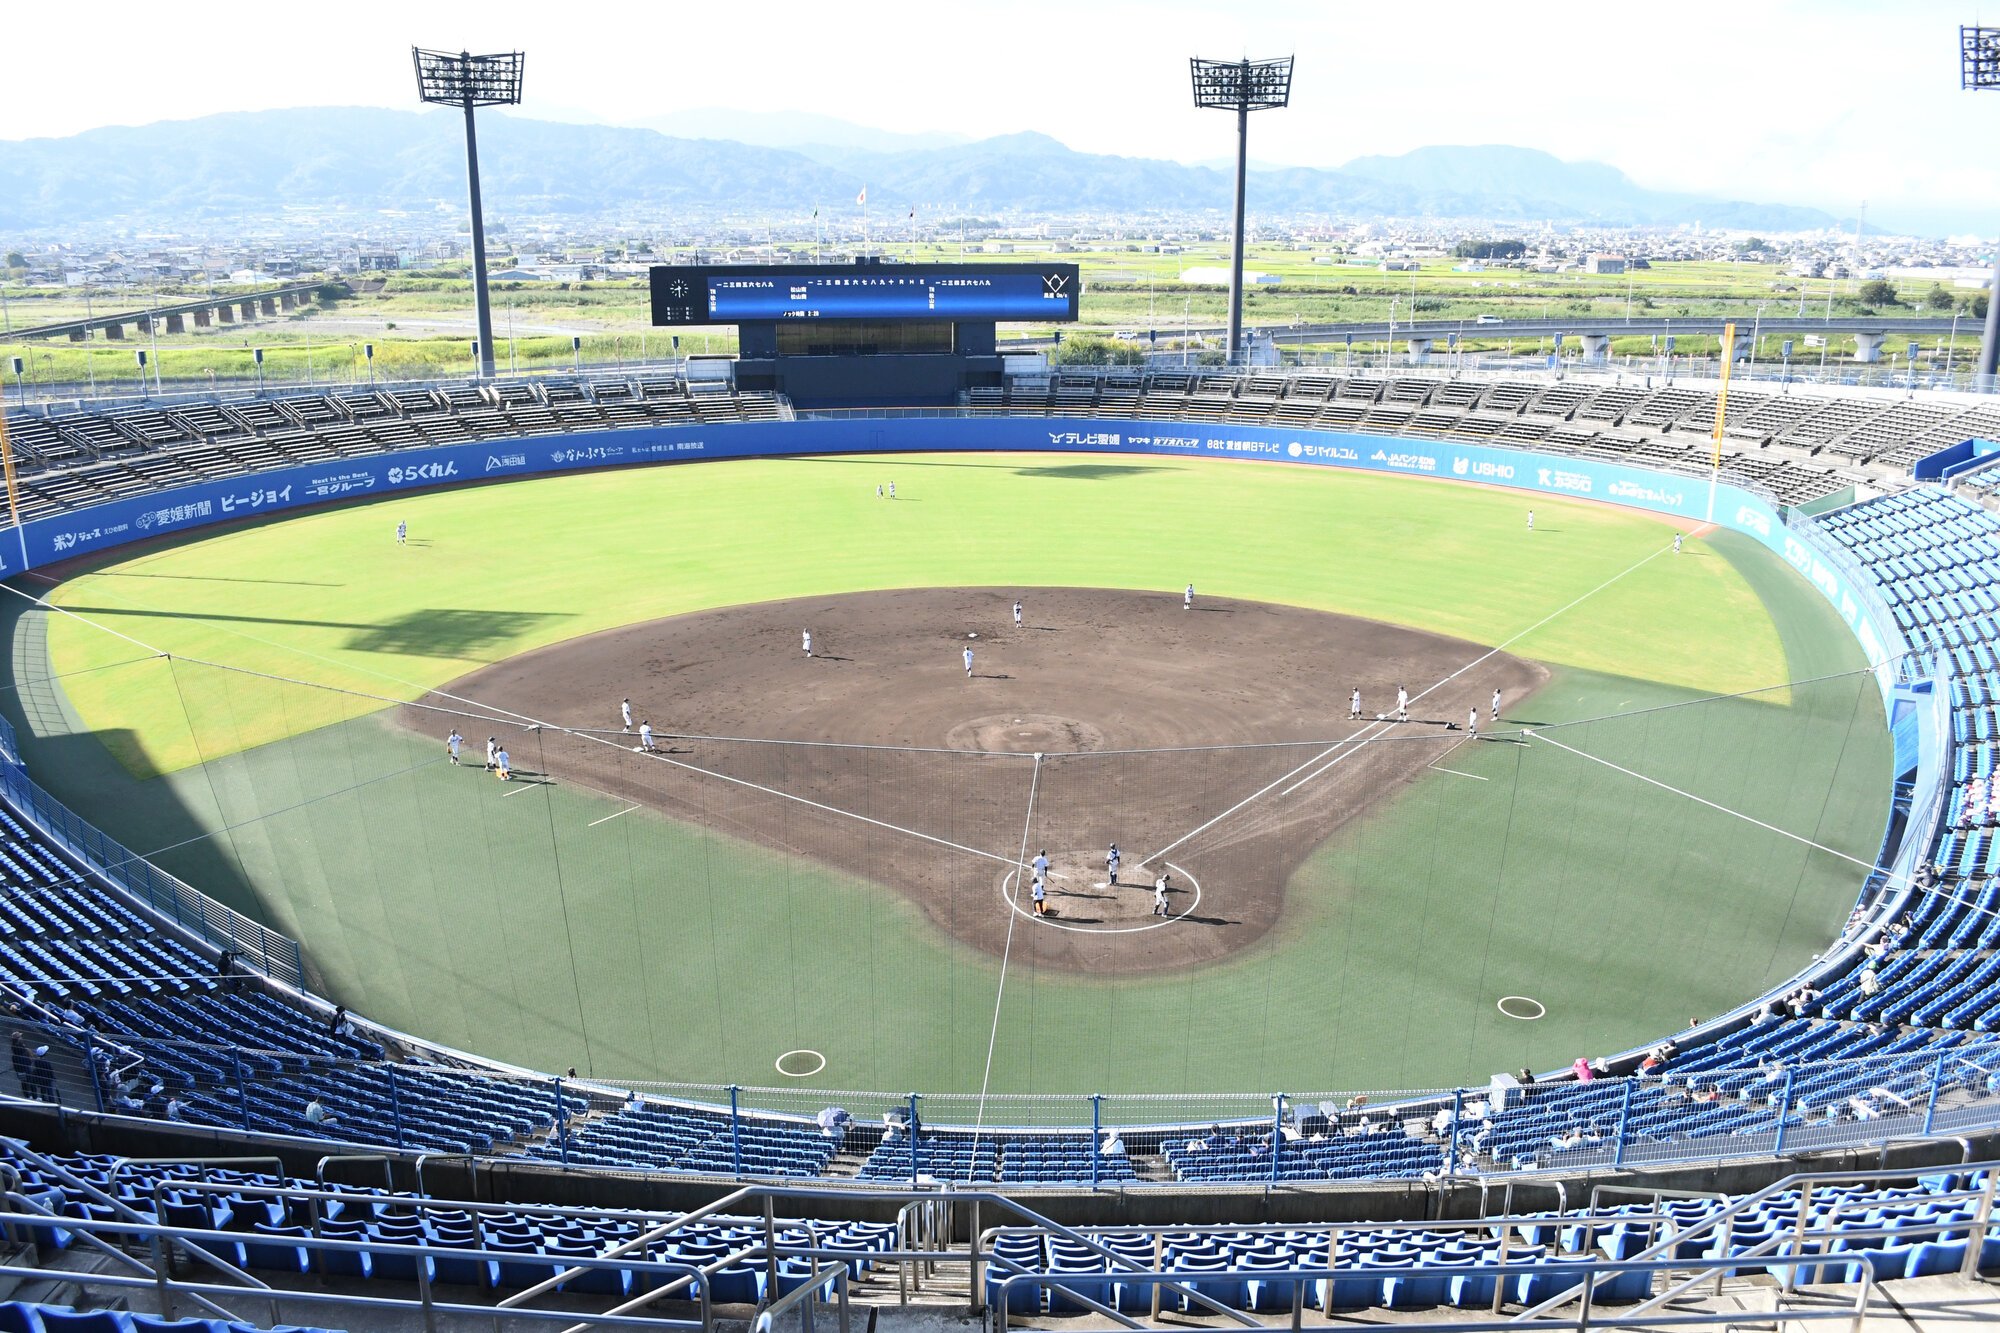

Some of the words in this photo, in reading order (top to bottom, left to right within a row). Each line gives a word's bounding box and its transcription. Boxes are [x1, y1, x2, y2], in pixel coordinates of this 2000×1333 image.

[676, 441, 704, 450] 南海放送
[1066, 433, 1120, 446] テレビ愛媛
[1127, 436, 1150, 444] ヤマキ
[1226, 440, 1280, 454] 愛媛朝日テレビ
[1303, 446, 1358, 460] モバイルコム
[501, 455, 526, 466] 浅田組
[405, 460, 459, 481] らくれん
[1472, 461, 1515, 479] USHIO
[312, 475, 328, 485] Next
[352, 471, 368, 479] Best
[305, 478, 375, 496] 一宮グループ
[221, 485, 292, 512] ビージョイ
[156, 500, 212, 526] 愛媛新聞
